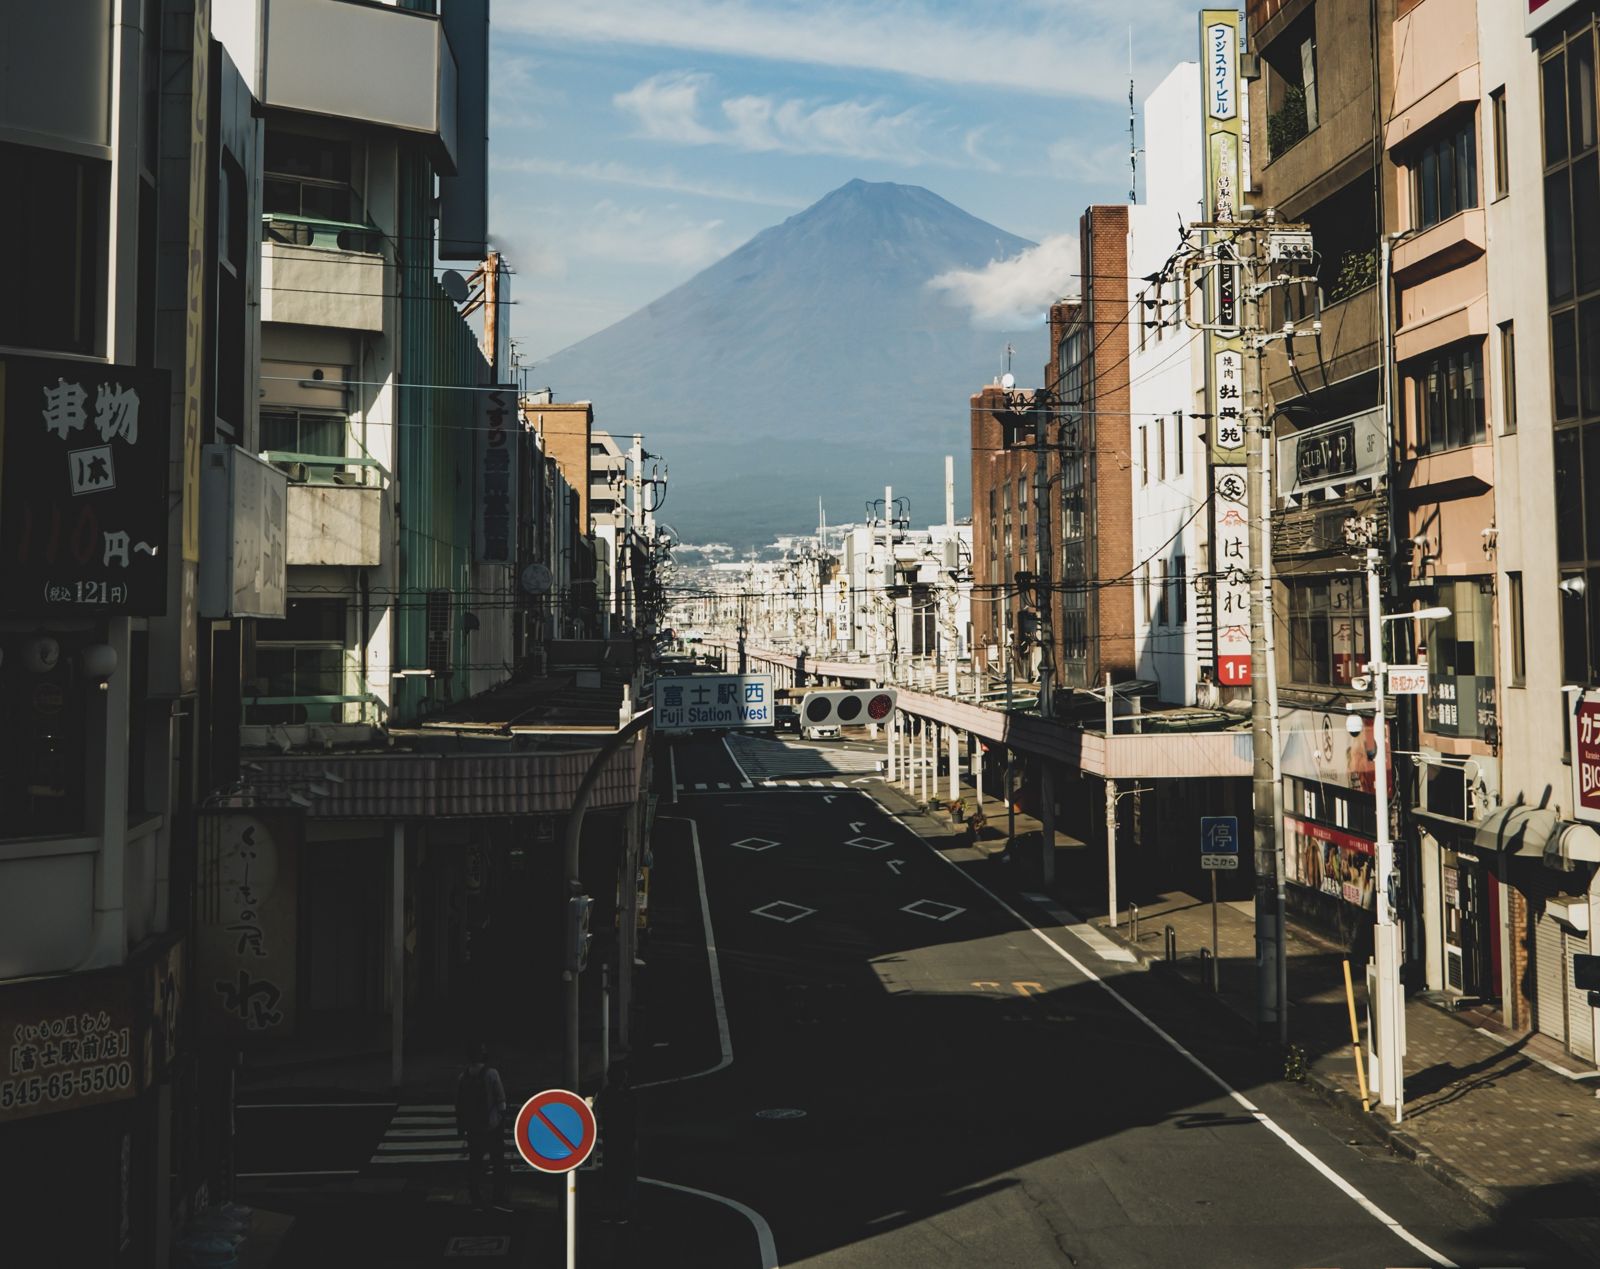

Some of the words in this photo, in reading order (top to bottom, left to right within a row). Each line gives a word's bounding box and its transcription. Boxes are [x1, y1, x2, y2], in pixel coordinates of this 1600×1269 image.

[1214, 28, 1229, 115] フジスカイビル
[41, 375, 141, 445] 串物
[1223, 537, 1246, 613] はなれ
[1225, 661, 1247, 679] 1F
[663, 682, 765, 707] 富士駅西
[660, 708, 685, 726] Fuji
[688, 707, 732, 724] Station
[737, 705, 768, 721] West
[1207, 823, 1232, 848] 停
[1203, 857, 1237, 867] ここから
[13, 1014, 79, 1044] くいもの屋
[80, 1010, 112, 1032] わん
[0, 1061, 132, 1109] 545-65-5500
